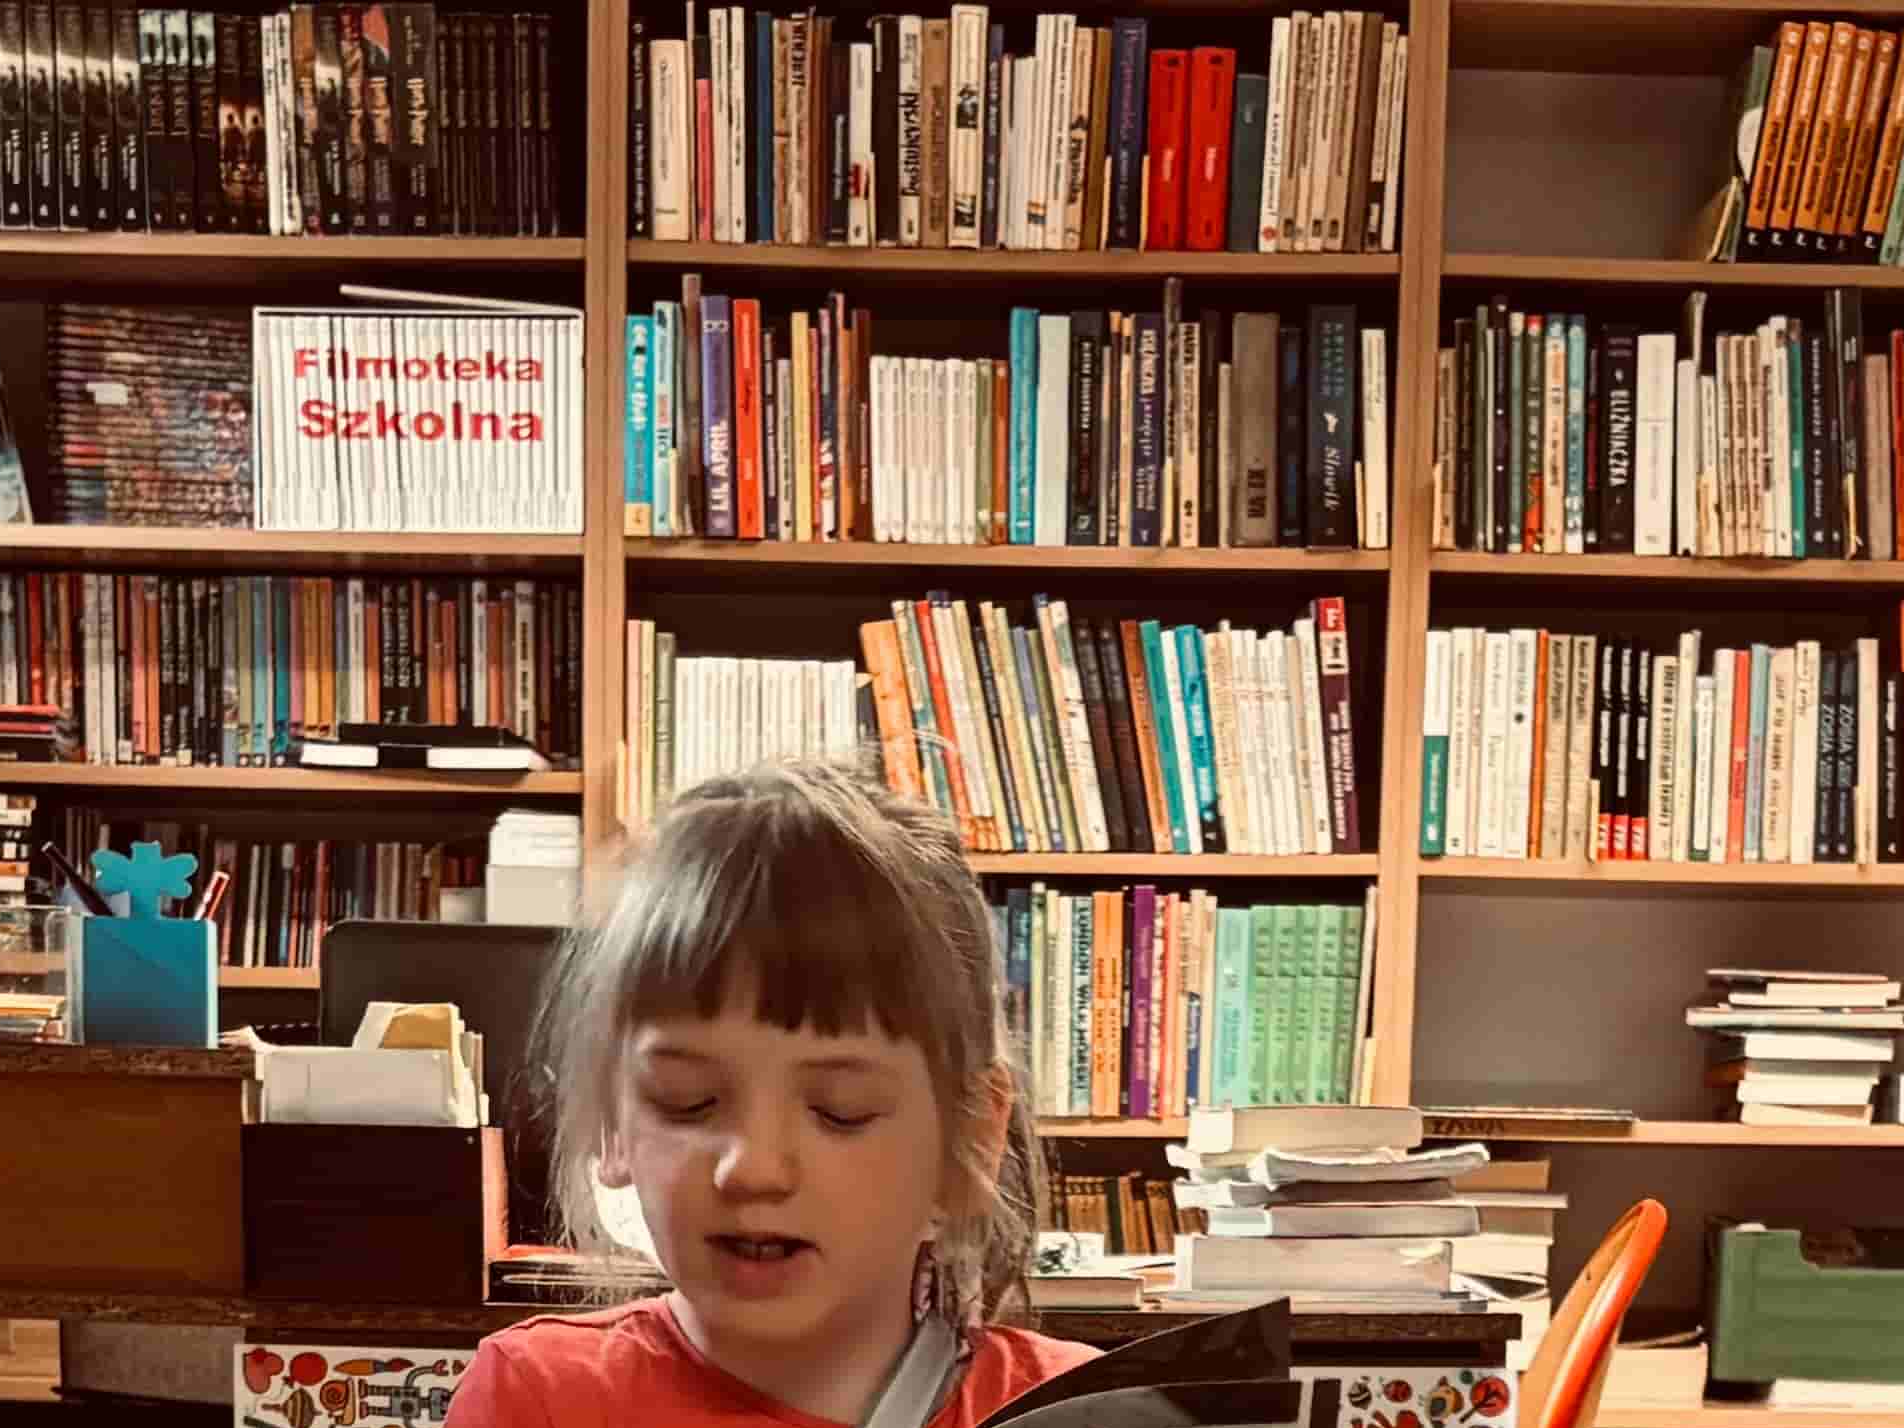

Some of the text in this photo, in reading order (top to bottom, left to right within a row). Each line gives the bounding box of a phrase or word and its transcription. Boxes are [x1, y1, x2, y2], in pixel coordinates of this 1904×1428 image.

[293, 349, 544, 383] Filmoteka
[299, 400, 544, 443] Szkolna
[1076, 905, 1091, 977] LONDON
